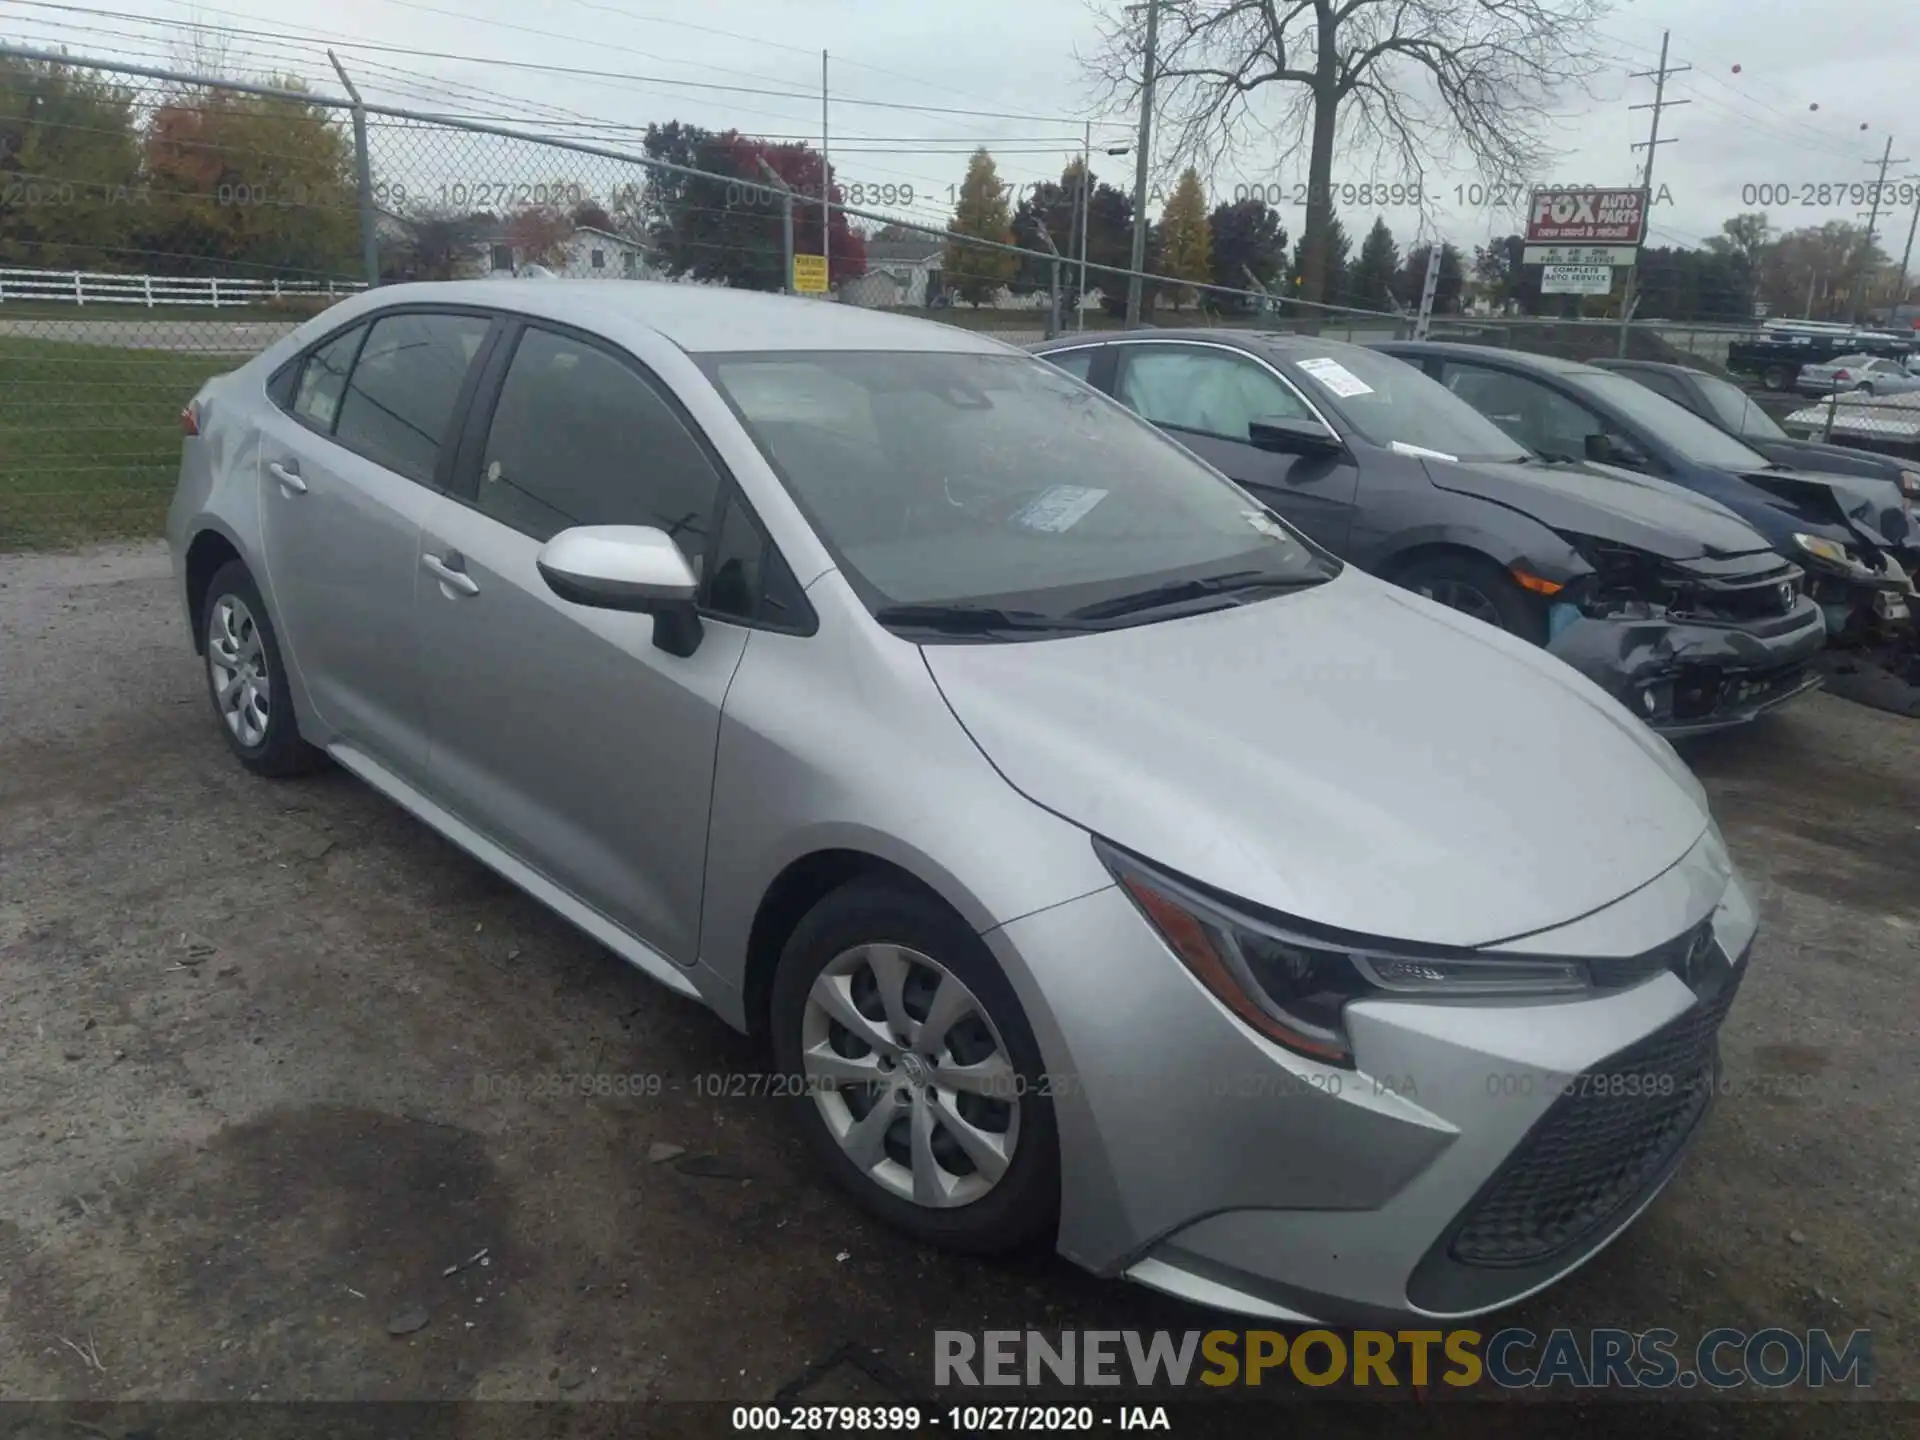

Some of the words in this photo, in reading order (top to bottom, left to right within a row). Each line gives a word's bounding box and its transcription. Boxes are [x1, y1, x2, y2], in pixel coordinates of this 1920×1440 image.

[1600, 194, 1637, 209] AUTO
[1533, 195, 1596, 224] FOX
[1597, 209, 1640, 224] PARTS
